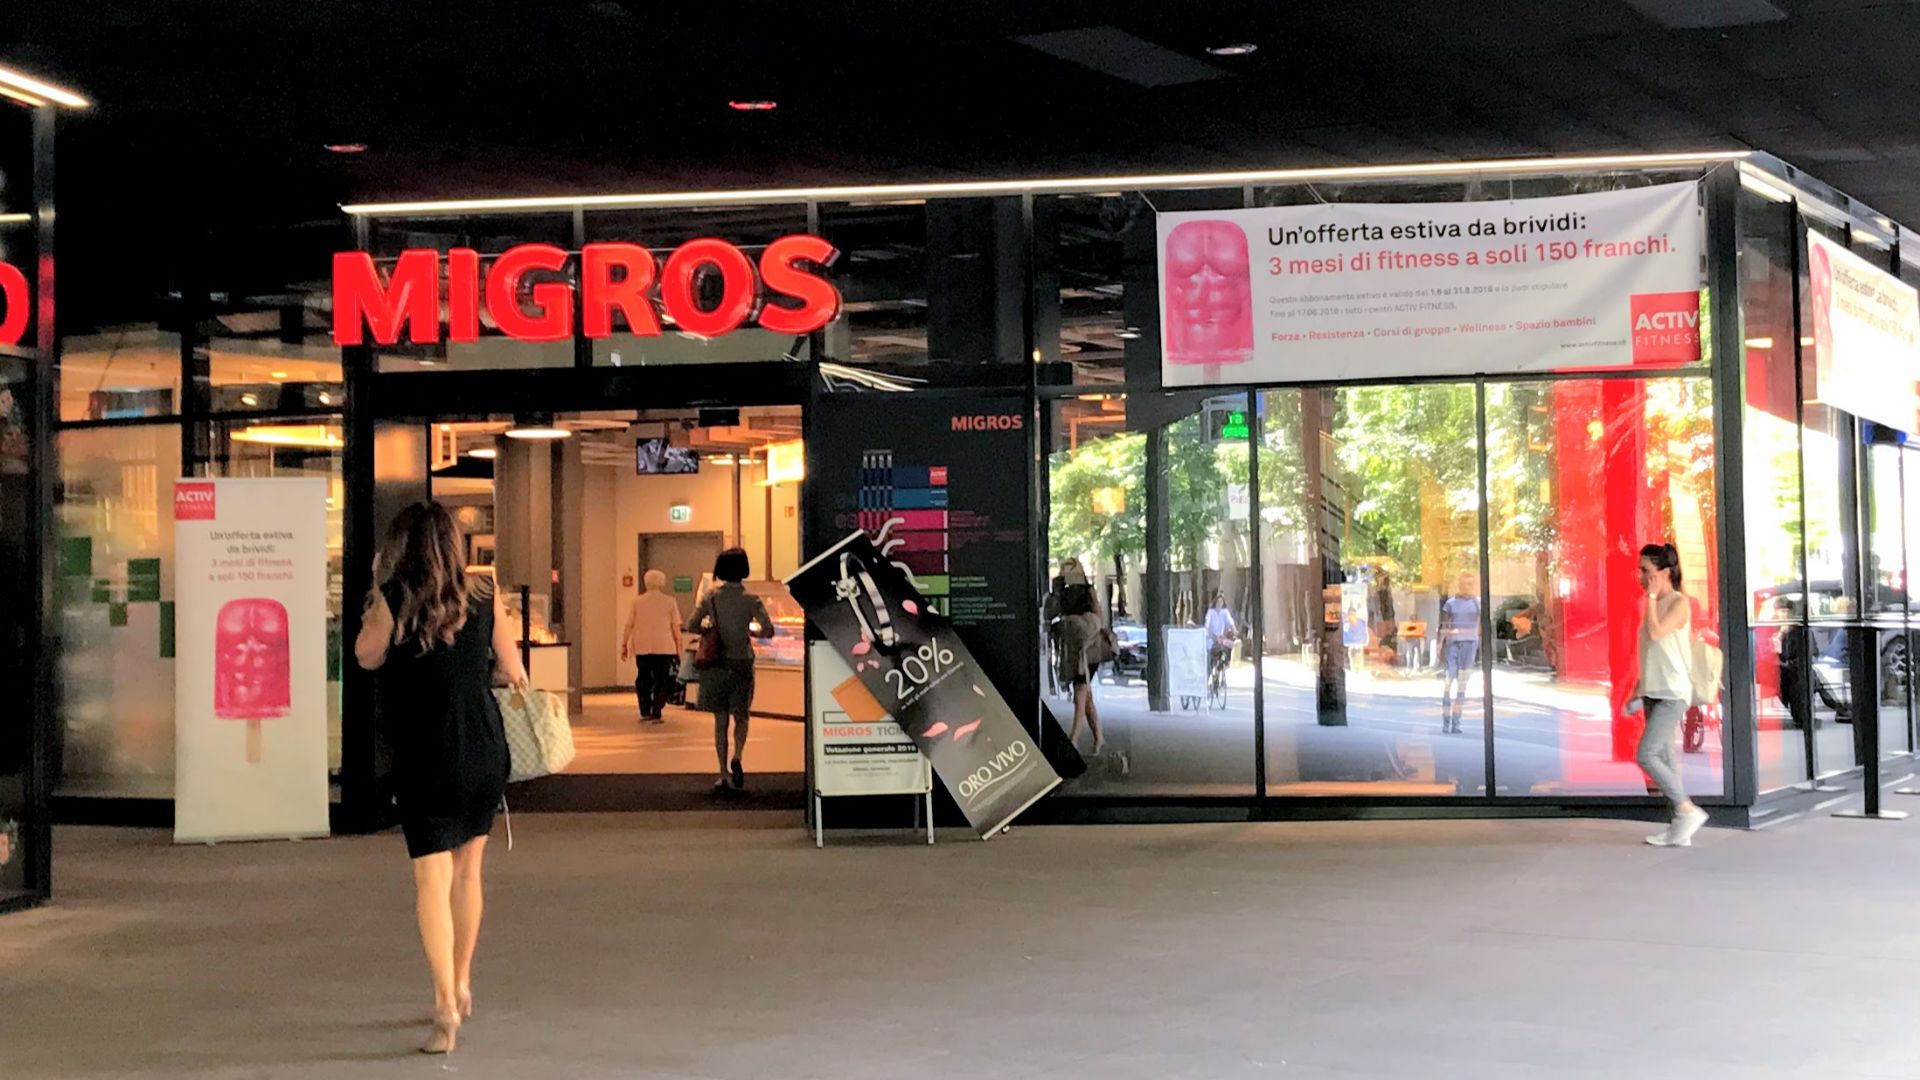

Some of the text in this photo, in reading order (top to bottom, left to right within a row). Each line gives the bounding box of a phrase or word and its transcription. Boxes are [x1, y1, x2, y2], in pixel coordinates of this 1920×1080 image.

[1268, 212, 1586, 246] Un'offerta estiva da brividi:
[1269, 234, 1676, 276] 3 mesi di fitness a soli 150 franchi.
[332, 235, 840, 345] MIGROS
[1269, 296, 1298, 304] Questo
[1300, 294, 1354, 302] abbonamento
[1389, 289, 1414, 298] valido
[1443, 288, 1451, 296] al
[1394, 304, 1417, 312] ACTIV
[1272, 317, 1596, 341] Forza Resistenza Corsi di gruppo Wellness Spazio bambini
[1635, 310, 1699, 330] ACTIV
[952, 414, 1024, 431] MIGROS
[176, 490, 213, 502] ACTIV
[885, 637, 954, 700] 20%
[823, 727, 902, 737] MIGROS TICI
[826, 746, 862, 754] Votazione
[863, 745, 896, 754] generale
[958, 766, 992, 797] ORO
[988, 740, 1026, 772] VIVO
